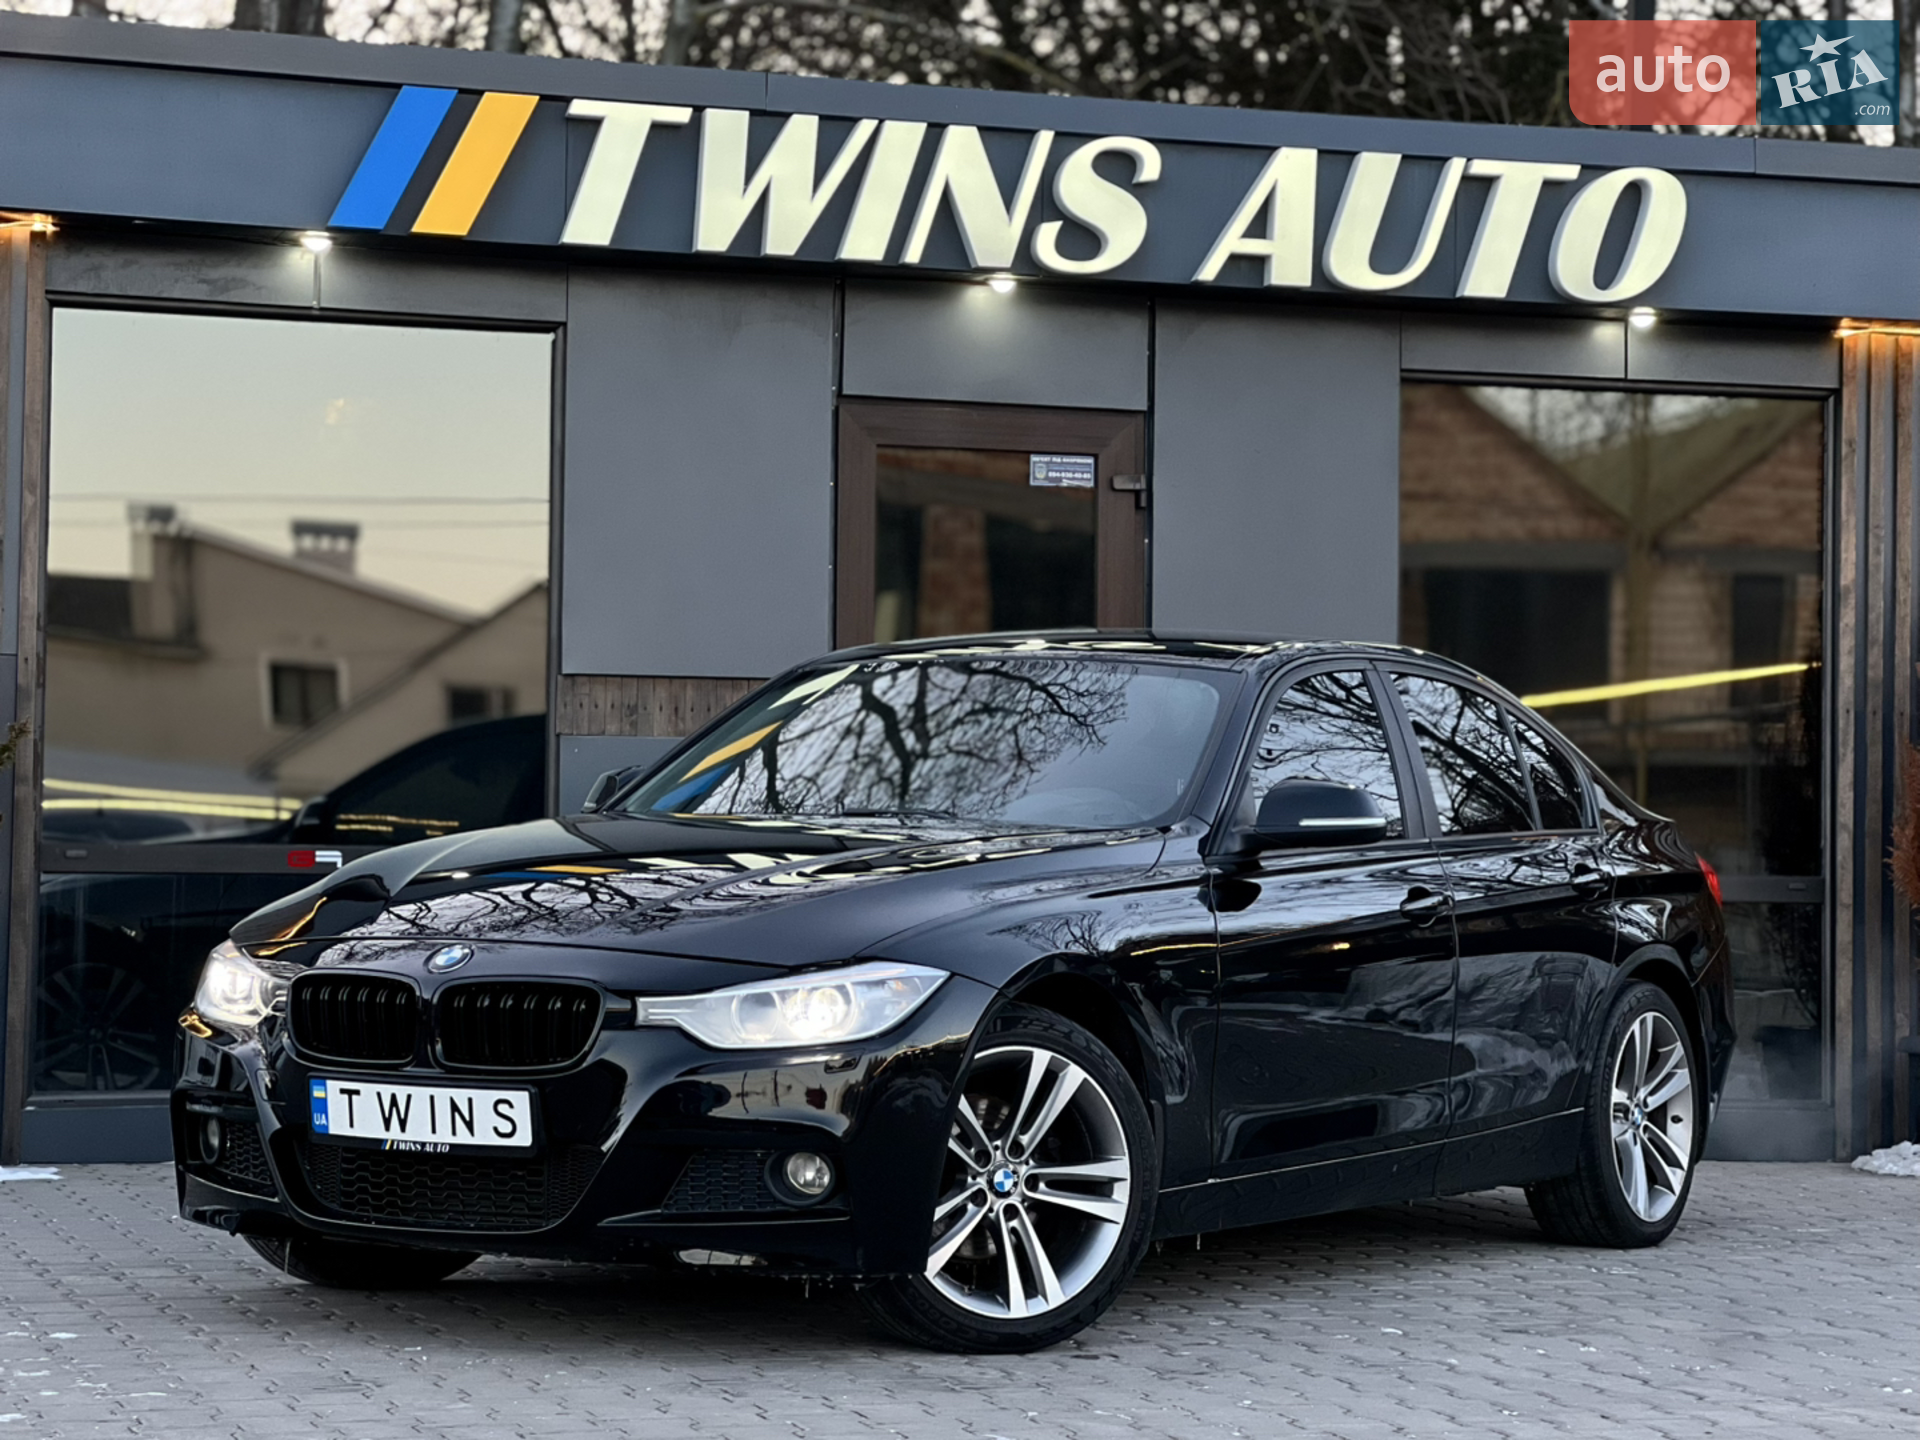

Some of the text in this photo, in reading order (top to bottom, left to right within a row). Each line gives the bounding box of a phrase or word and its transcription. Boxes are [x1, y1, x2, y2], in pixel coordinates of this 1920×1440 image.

[559, 98, 1688, 303] TWINS AUTO
[313, 1112, 328, 1126] UA
[339, 1088, 517, 1139] TWINS
[392, 1140, 450, 1153] TWINS AUTO
